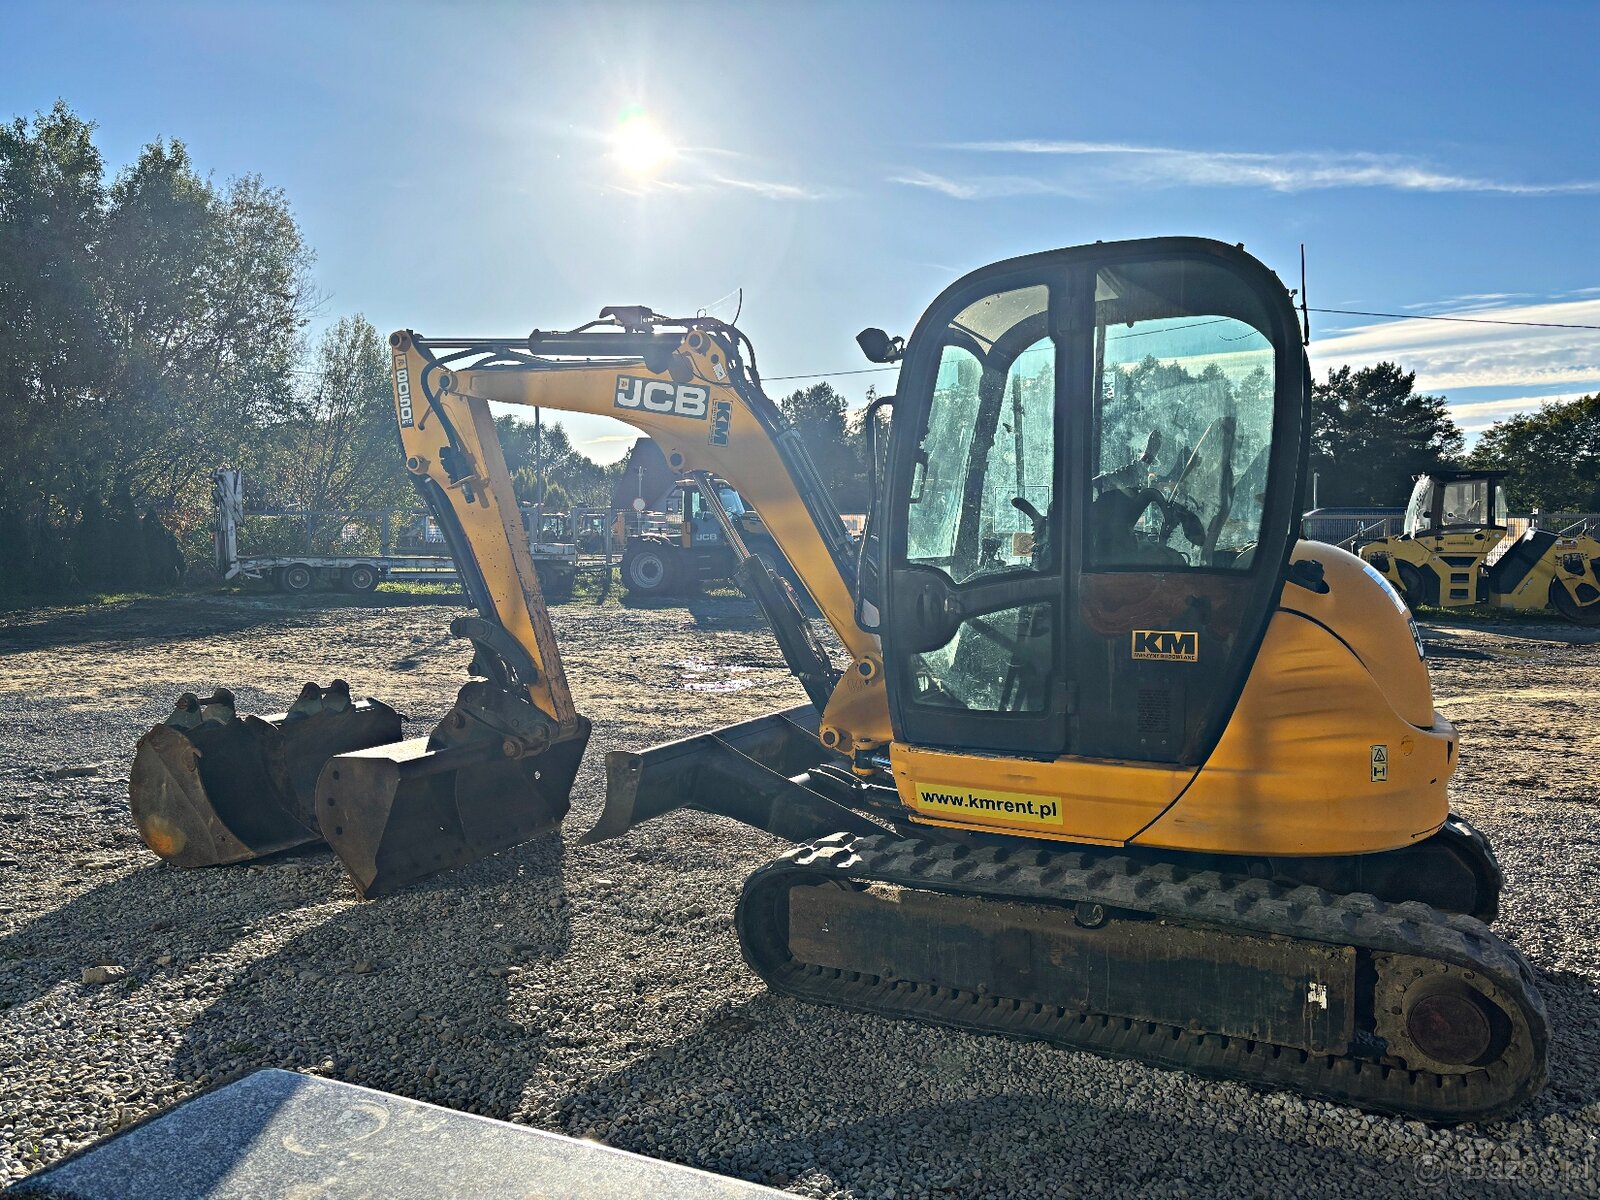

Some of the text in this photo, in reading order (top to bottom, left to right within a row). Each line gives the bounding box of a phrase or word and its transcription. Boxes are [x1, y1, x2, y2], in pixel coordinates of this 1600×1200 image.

[396, 369, 412, 419] 8050
[617, 379, 706, 415] JCB
[713, 401, 730, 444] KM
[1135, 632, 1195, 654] KM
[921, 791, 1057, 819] www.kmrent.pl
